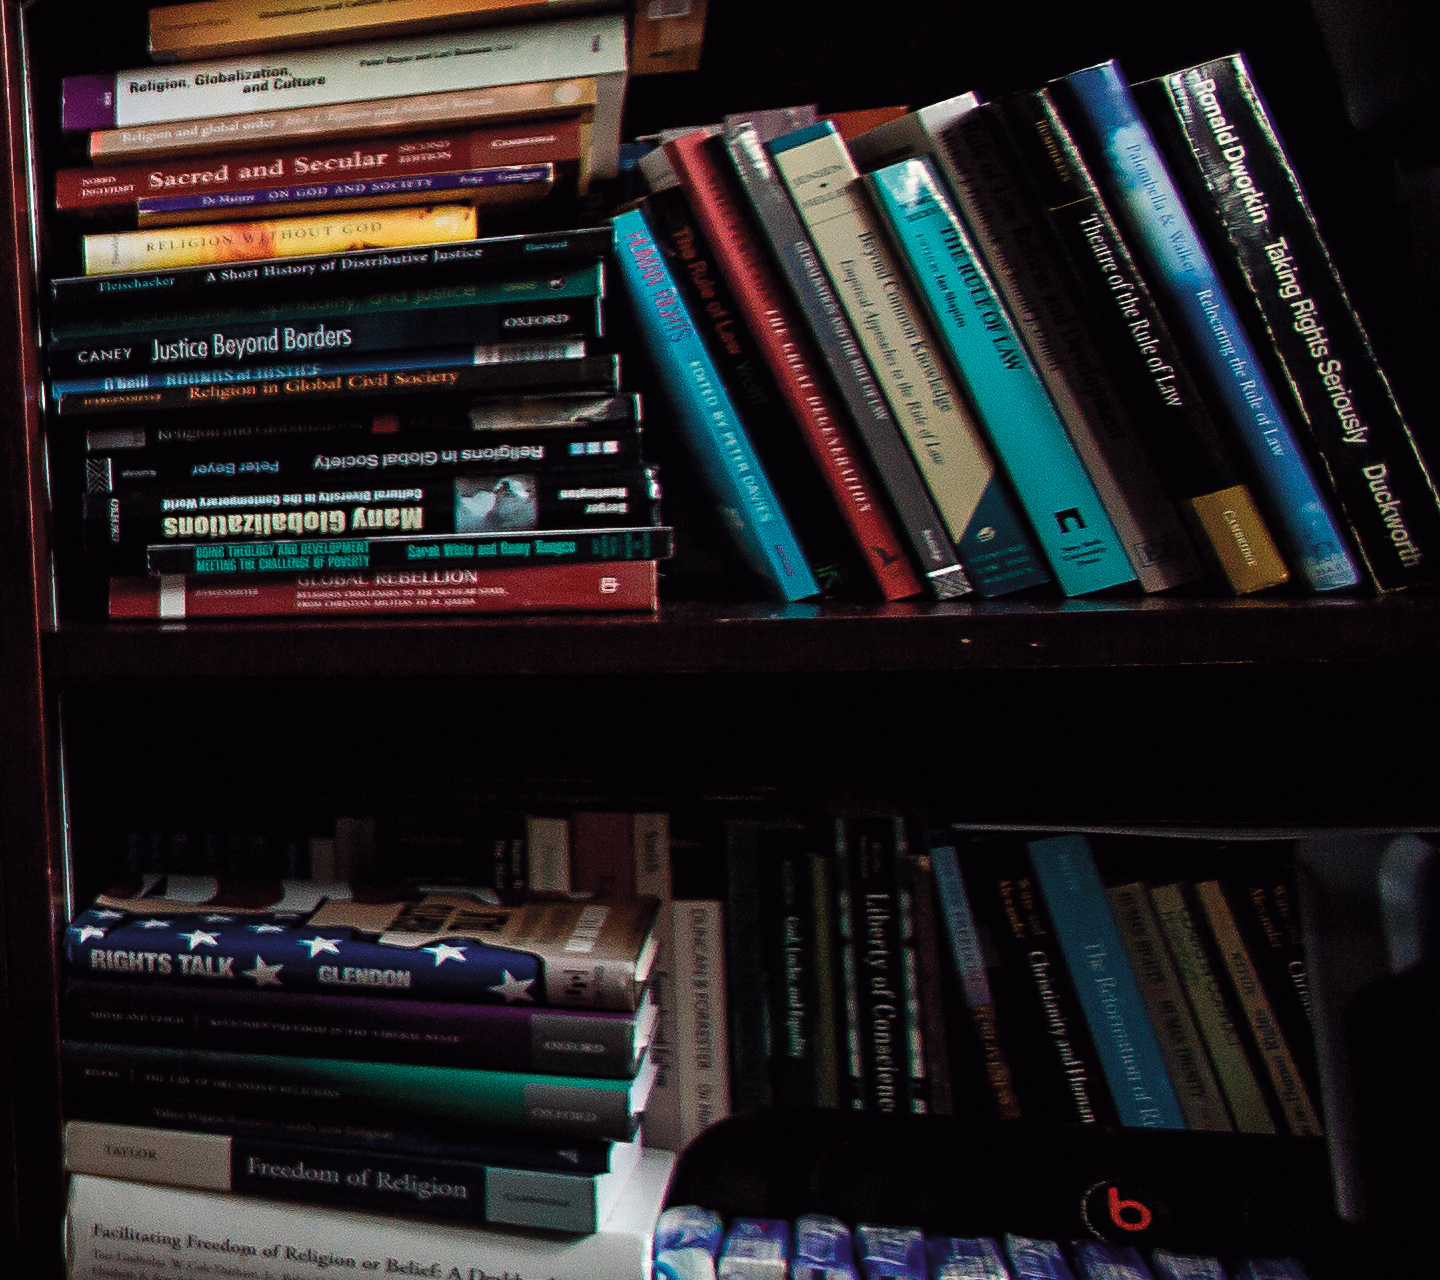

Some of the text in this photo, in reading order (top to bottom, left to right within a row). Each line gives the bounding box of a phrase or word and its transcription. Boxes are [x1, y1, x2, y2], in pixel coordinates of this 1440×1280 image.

[242, 73, 326, 95] and Culture
[149, 148, 389, 190] Sacred and Secular
[1193, 77, 1270, 224] Ronald Dworkin
[145, 221, 383, 252] RELIGION WITHOUT GOD
[205, 245, 485, 282] A Short History of Distributive Justice
[1079, 213, 1183, 406] Theatre of the Rule of Law
[77, 347, 132, 365] CANEY
[150, 324, 352, 364] Justice Beyond Borders
[1264, 236, 1369, 447] Taking Rights Seriously
[162, 507, 425, 539] Many Globalizations
[1362, 462, 1424, 568] Duckworth
[89, 947, 235, 979] RIGHTS TALK
[318, 964, 411, 990] GLENDON
[104, 1144, 158, 1162] TAYLOR
[246, 1157, 469, 1200] Freedom of Religion
[91, 1224, 182, 1252] Facilitating
[185, 1231, 260, 1258] Freedom
[262, 1239, 282, 1260] of
[284, 1244, 357, 1274] Religion
[361, 1257, 380, 1270] or
[447, 1264, 463, 1280] A
